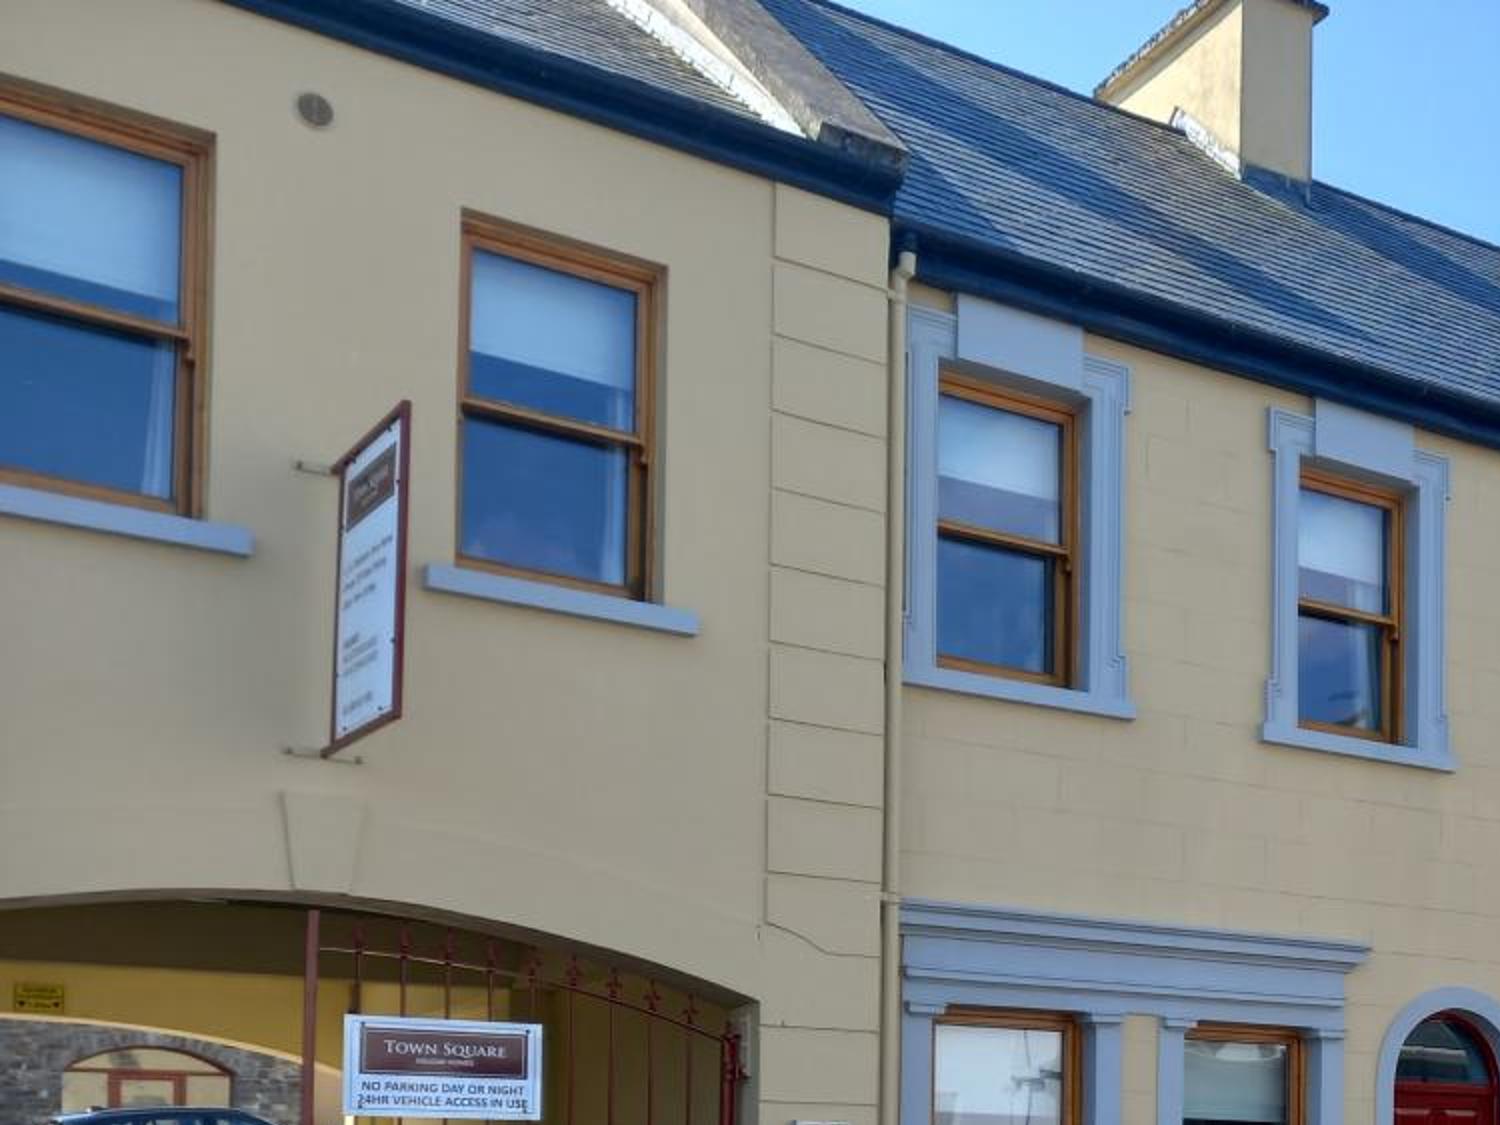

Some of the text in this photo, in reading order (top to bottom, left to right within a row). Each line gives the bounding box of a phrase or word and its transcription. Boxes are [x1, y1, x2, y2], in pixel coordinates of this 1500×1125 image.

[384, 1039, 508, 1059] TOWN SQUARE
[361, 1081, 525, 1097] NO PARKING DAY OR NIGHT
[391, 1096, 441, 1108] VEHICLE
[445, 1098, 489, 1109] ACCESS
[506, 1100, 529, 1110] USE
